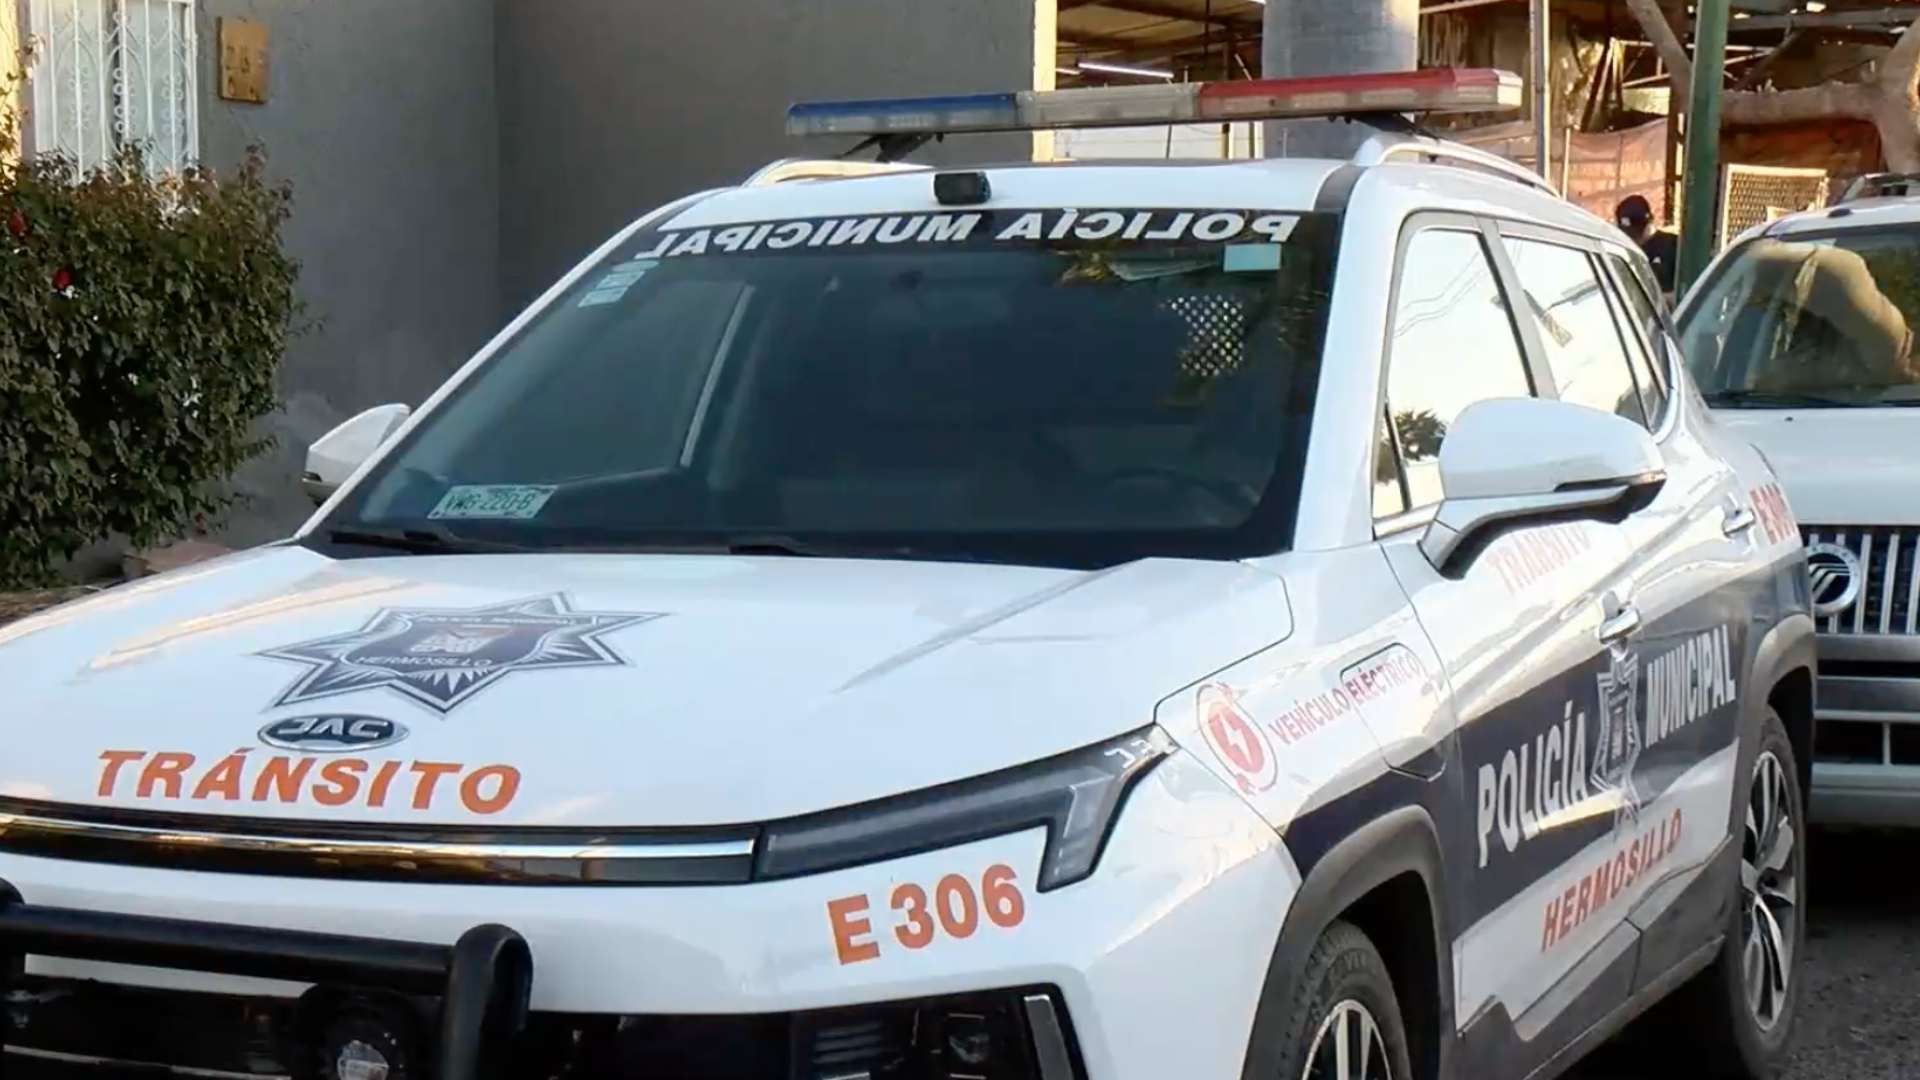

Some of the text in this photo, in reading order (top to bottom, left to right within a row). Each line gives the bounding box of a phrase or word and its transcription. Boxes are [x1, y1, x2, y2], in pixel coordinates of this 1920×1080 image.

[277, 717, 390, 740] JAC
[1268, 649, 1424, 745] VEHÍCULO ELÉCTRICO
[1477, 623, 1736, 868] POLICÍA MUNICIPAL
[98, 748, 521, 815] TRÁNSITO
[827, 863, 1025, 965] E 306
[1540, 808, 1683, 952] HERMOSILLO
